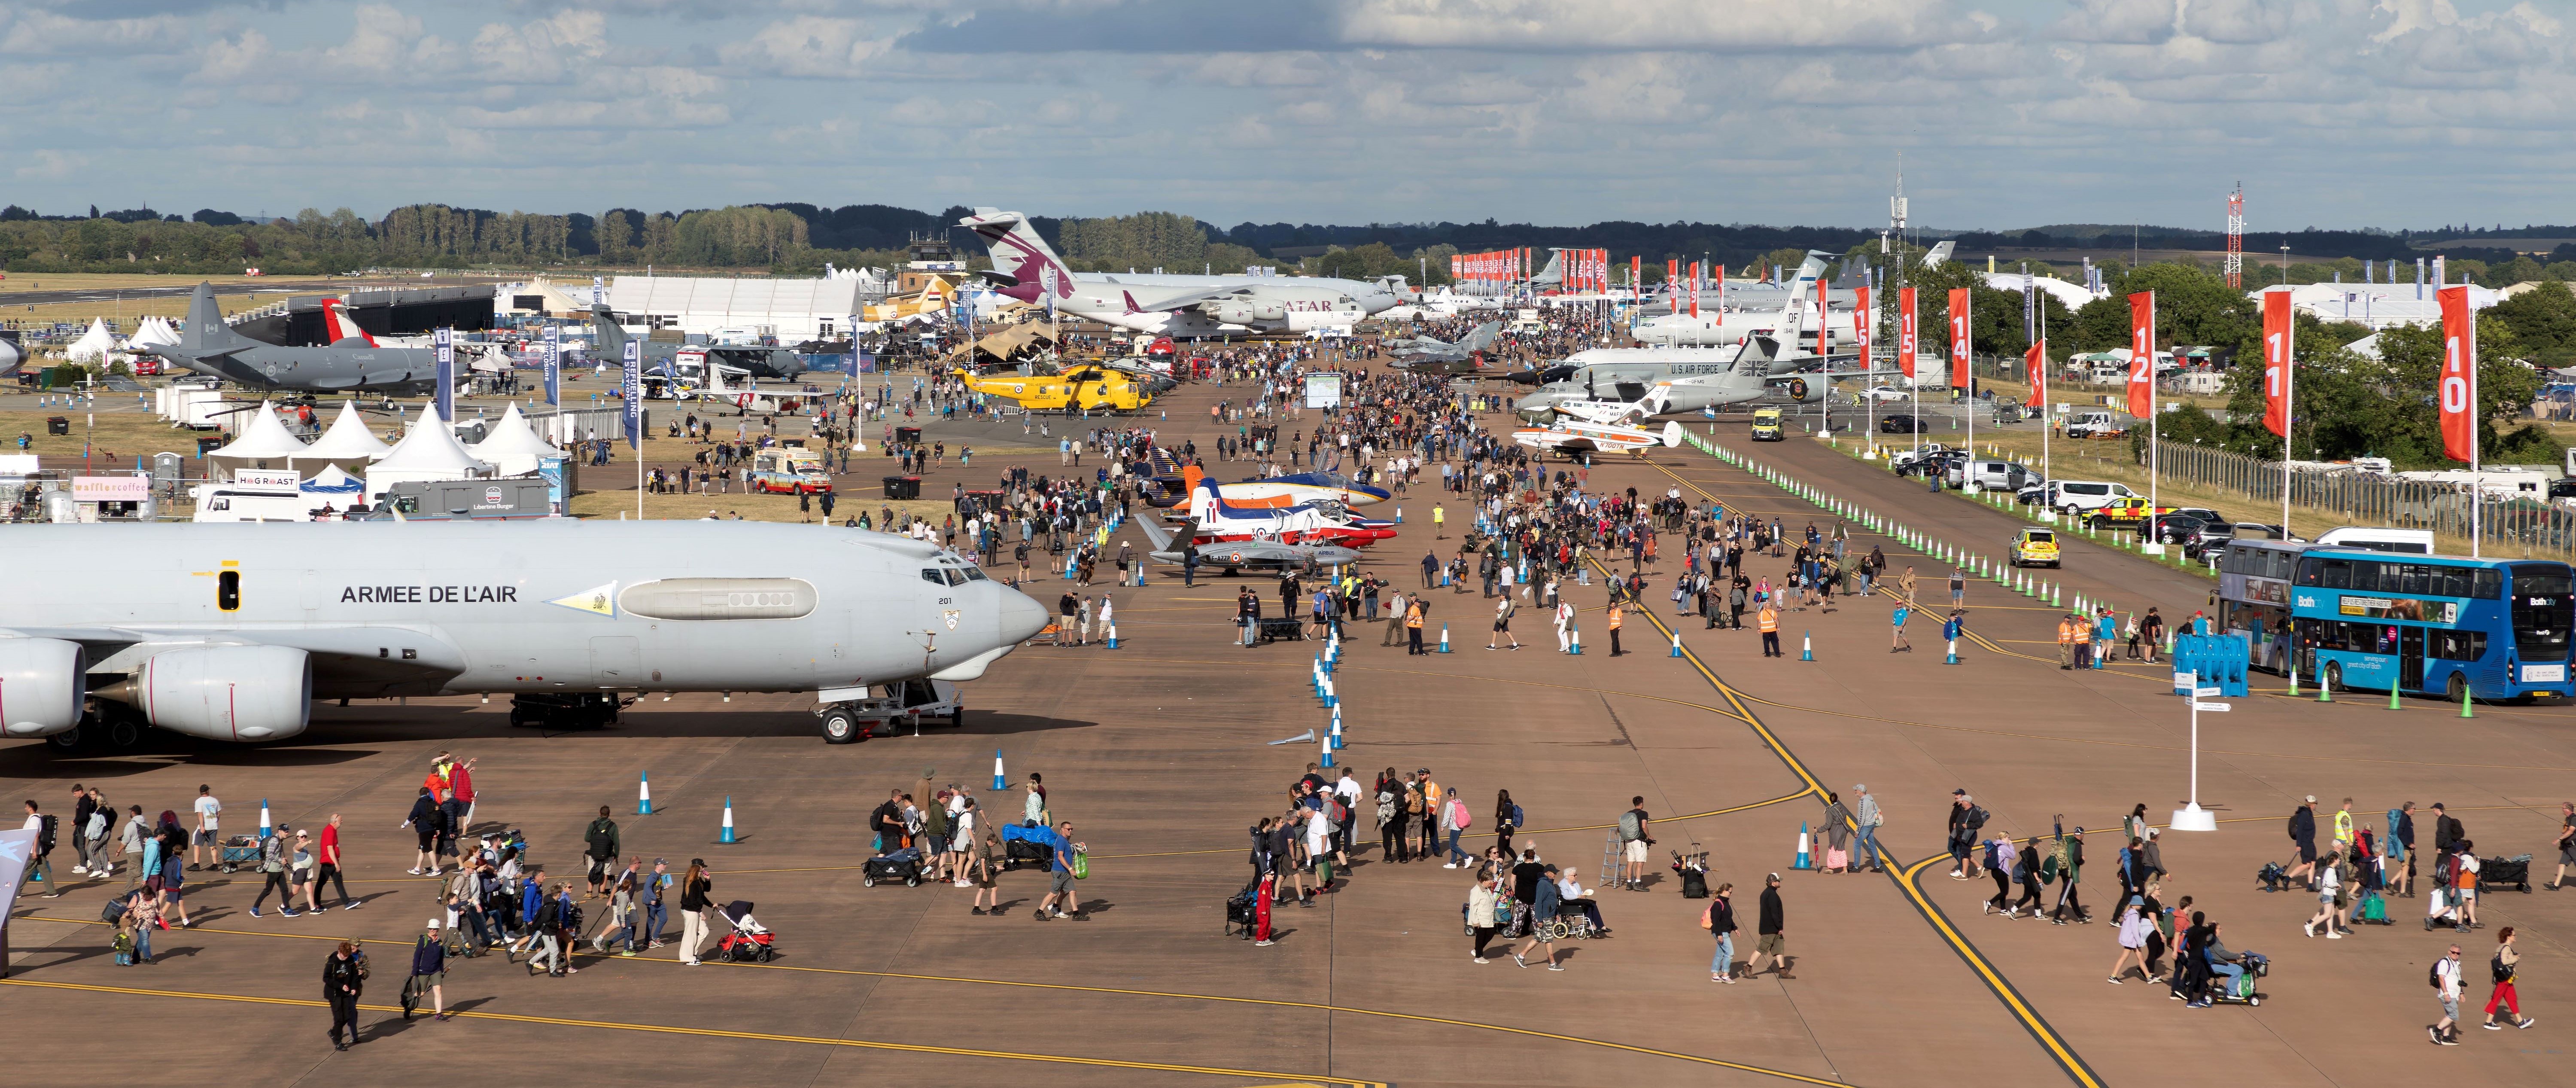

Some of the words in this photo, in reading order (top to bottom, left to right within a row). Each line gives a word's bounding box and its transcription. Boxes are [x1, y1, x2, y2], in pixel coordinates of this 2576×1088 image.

[1514, 257, 1518, 271] 29
[1578, 260, 1583, 277] 25
[1586, 260, 1592, 278] 24
[1600, 263, 1605, 283] 22
[1633, 270, 1638, 293] 21
[1670, 275, 1676, 299] 20
[1691, 278, 1697, 303] 19
[1284, 301, 1332, 311] ATAR
[1789, 313, 1798, 323] OF
[1856, 310, 1867, 346] 16
[1903, 313, 1913, 354] 15
[1953, 316, 1967, 360] 14
[2132, 327, 2148, 383] 12
[2266, 332, 2282, 397] 11
[1685, 365, 1695, 374] AIR
[1697, 365, 1718, 374] FORCE
[2444, 336, 2467, 413] 10
[75, 483, 110, 491] waffle
[118, 483, 145, 491] coffee
[341, 586, 421, 603] ARMEE
[429, 586, 458, 603] DE
[465, 586, 517, 603] L'AIR
